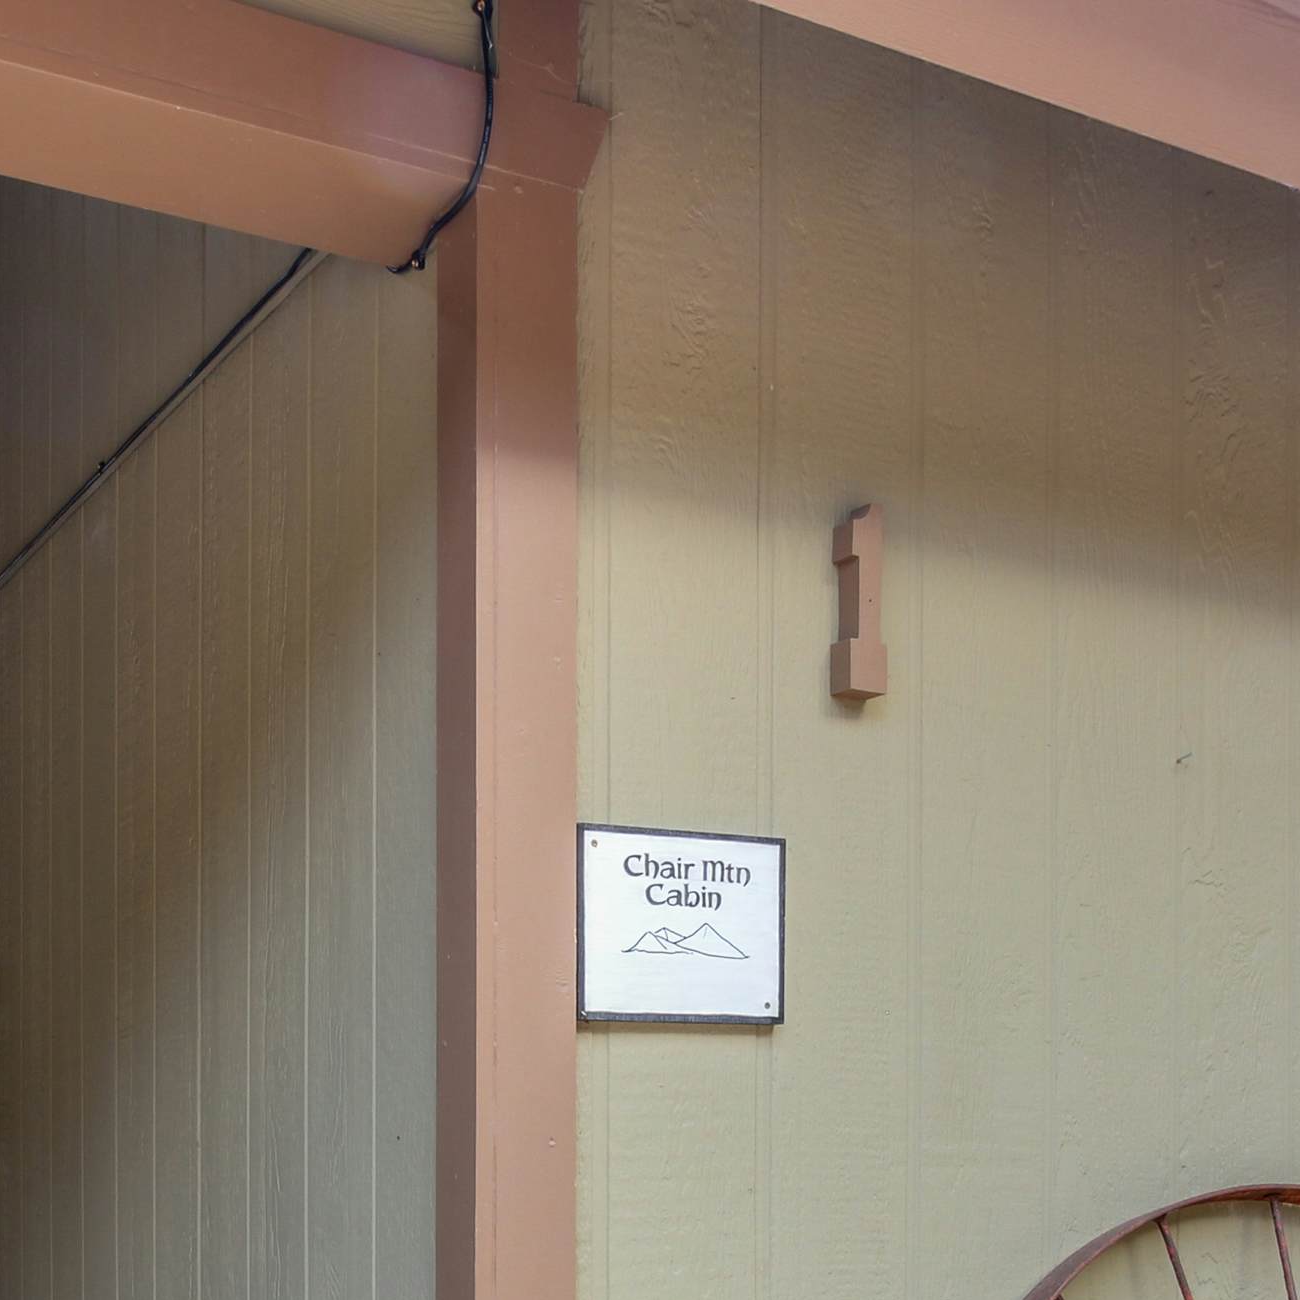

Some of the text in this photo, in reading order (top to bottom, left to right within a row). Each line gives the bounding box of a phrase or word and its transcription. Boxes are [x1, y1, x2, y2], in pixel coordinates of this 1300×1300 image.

[624, 853, 751, 887] Chair Mtn
[645, 884, 722, 911] Cabin
